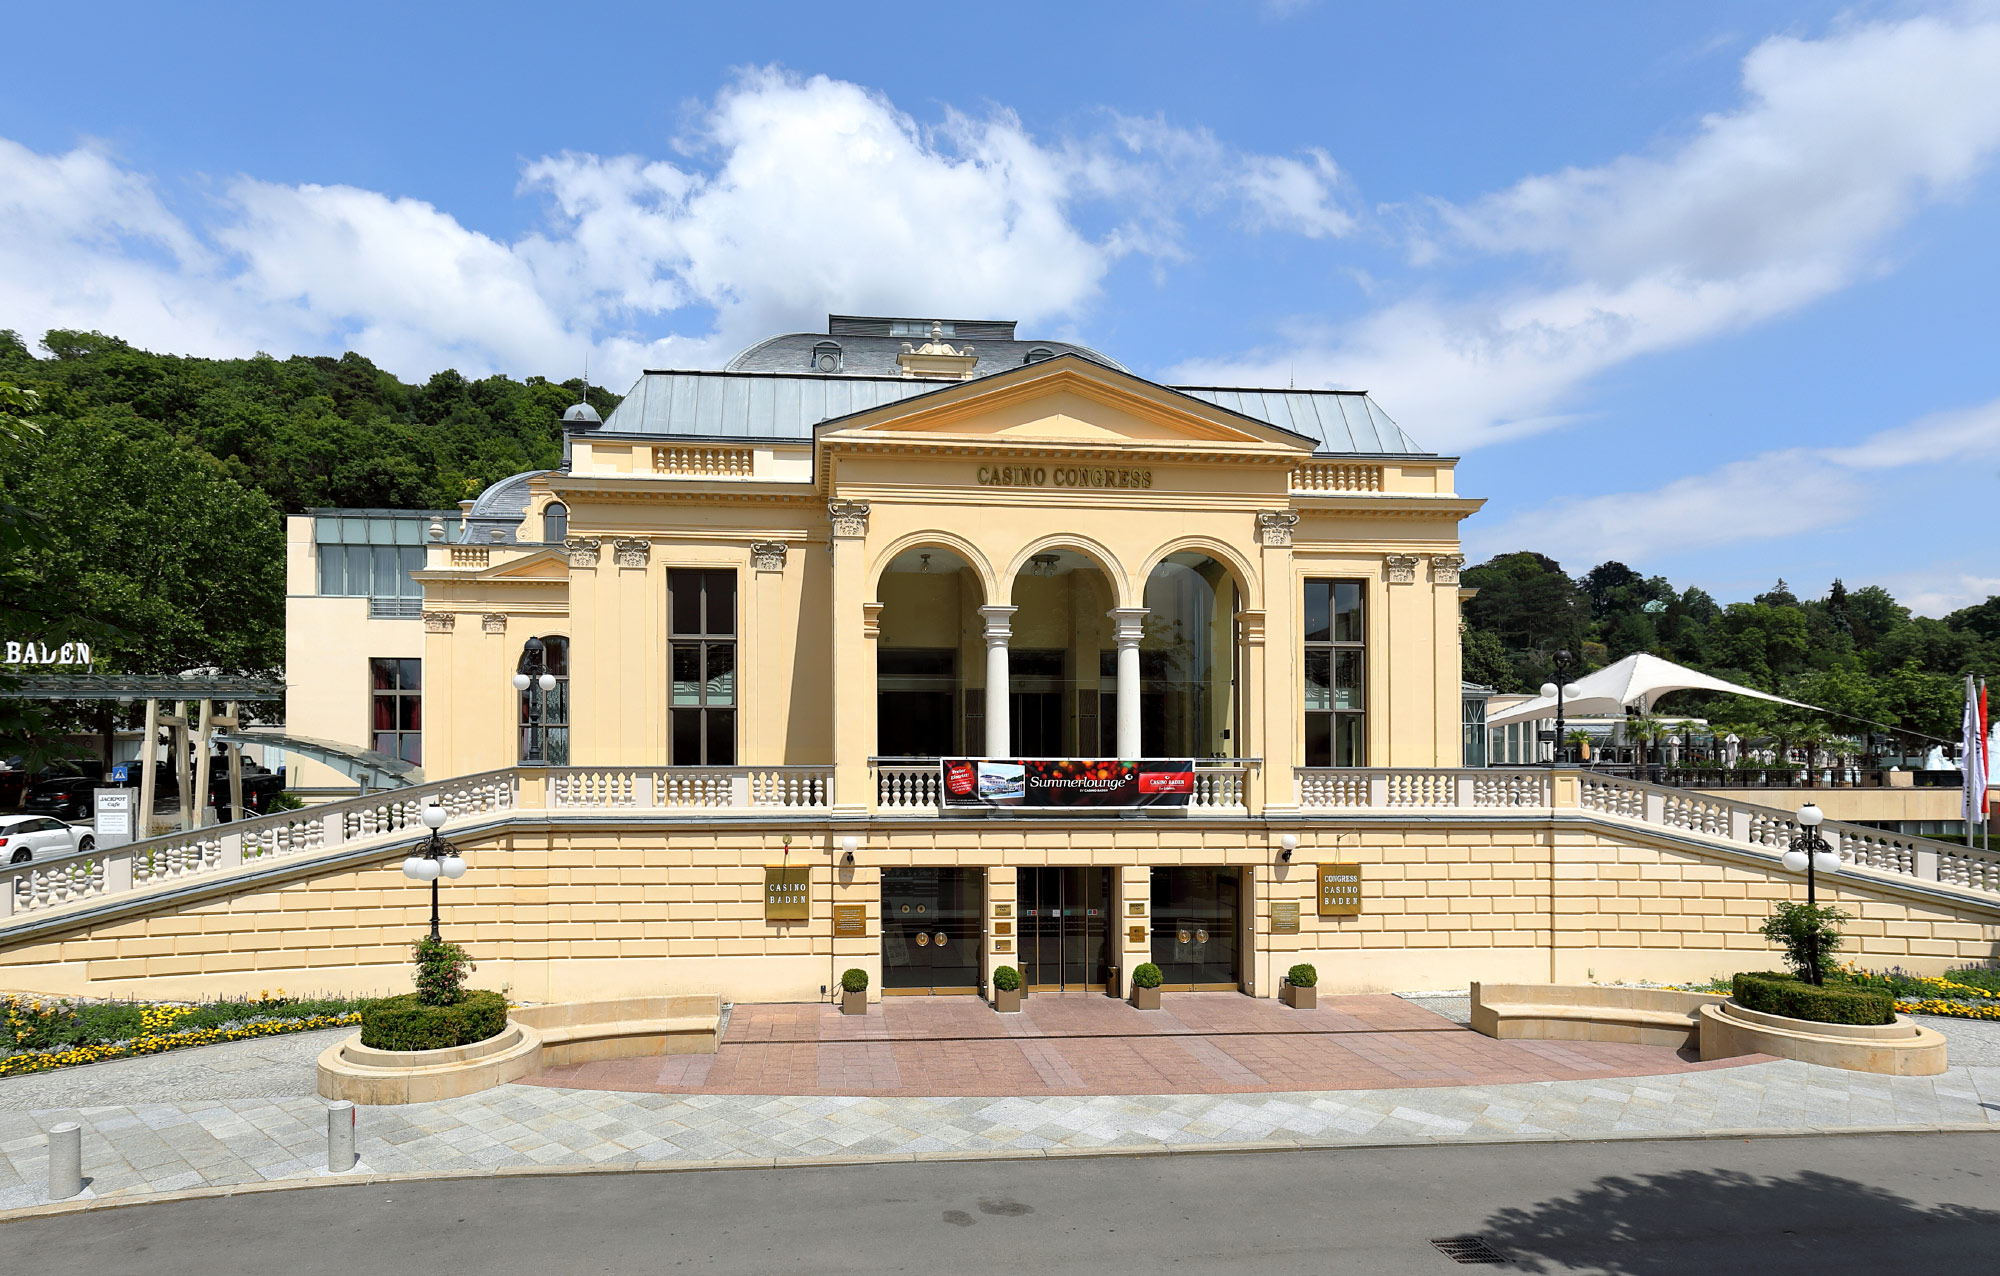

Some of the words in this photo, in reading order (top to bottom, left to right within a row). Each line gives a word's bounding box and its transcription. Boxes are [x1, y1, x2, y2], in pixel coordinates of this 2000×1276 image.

[977, 466, 1046, 486] CASINO
[1053, 467, 1153, 488] CONGRESS
[1030, 776, 1126, 790] Summerlounge
[1324, 875, 1358, 883] CONGRESS
[769, 883, 806, 892] CASINO
[1324, 886, 1358, 894] CASINO
[769, 896, 806, 904] BADEN
[1324, 897, 1358, 905] BADEN
